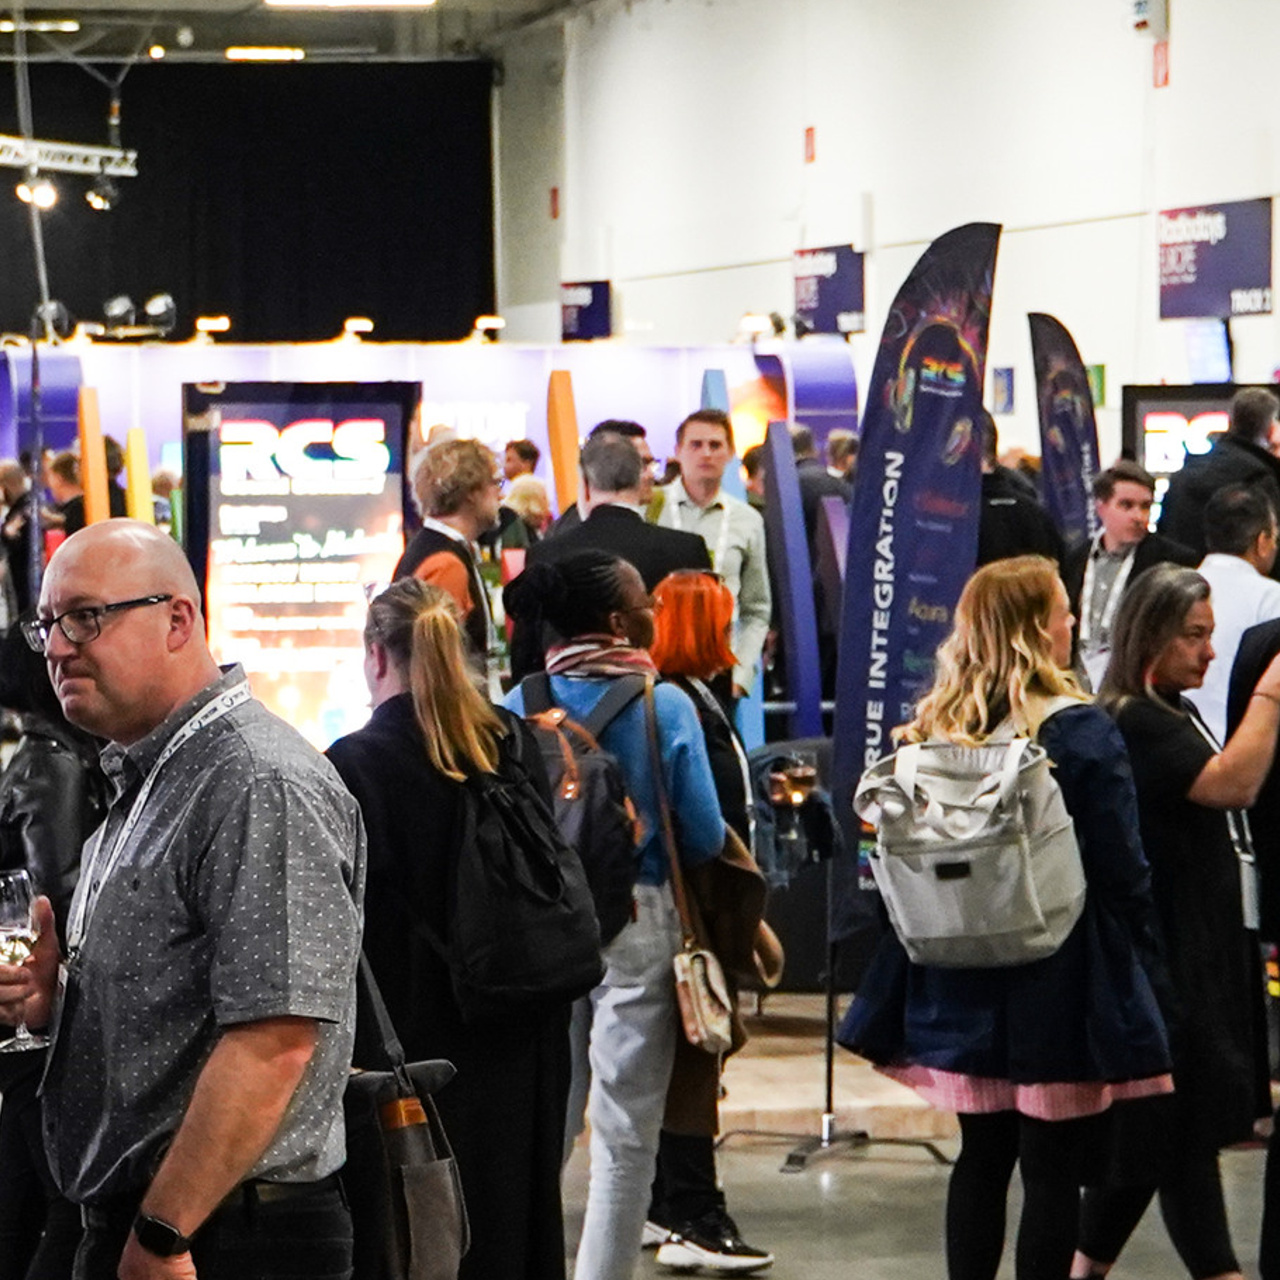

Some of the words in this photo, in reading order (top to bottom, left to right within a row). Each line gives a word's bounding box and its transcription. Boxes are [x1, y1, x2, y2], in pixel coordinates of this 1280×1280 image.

[219, 419, 391, 481] RCS
[1143, 411, 1230, 474] RC
[868, 452, 904, 689] INTEGRATION
[864, 700, 884, 769] RUE
